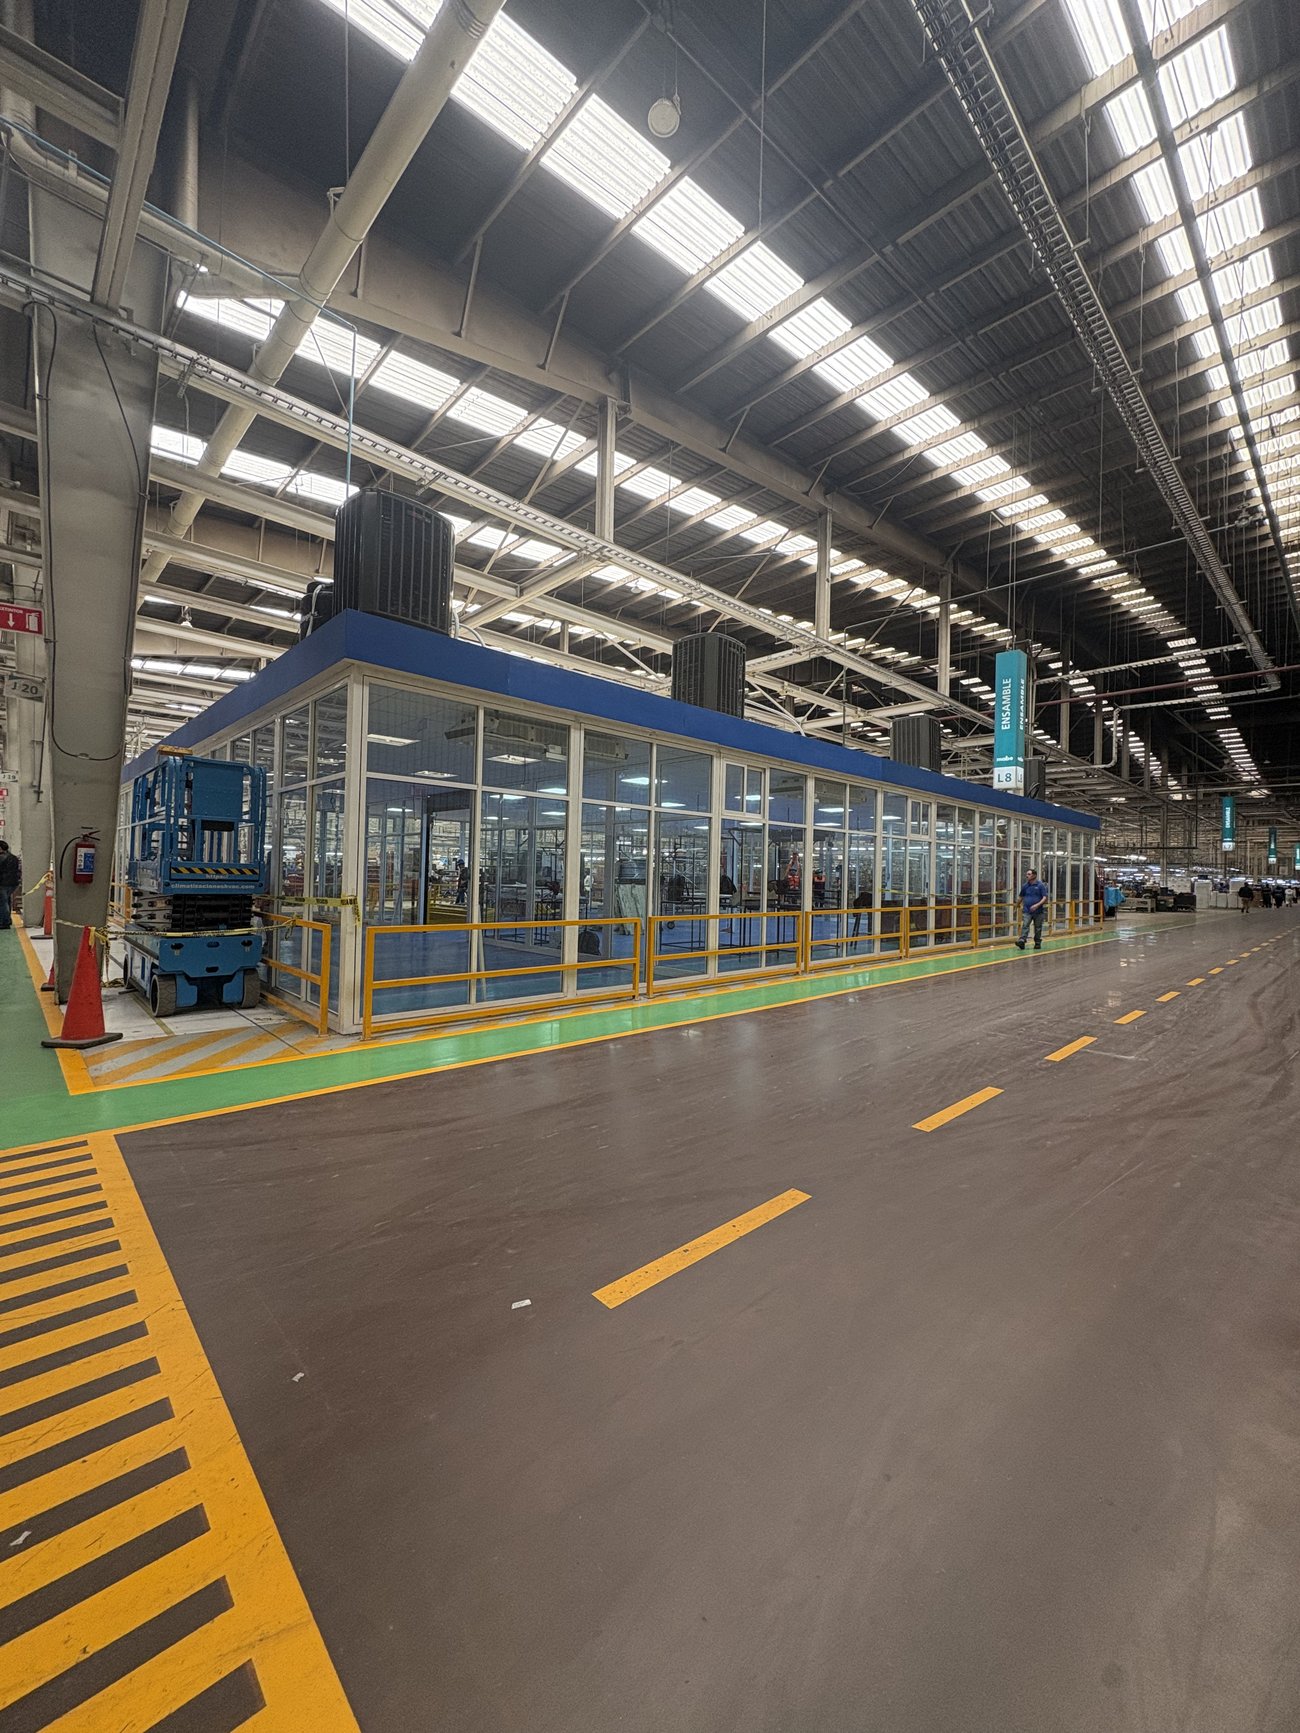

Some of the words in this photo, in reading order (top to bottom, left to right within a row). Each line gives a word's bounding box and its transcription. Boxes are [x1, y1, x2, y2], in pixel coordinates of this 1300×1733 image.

[11, 681, 17, 690] J
[21, 683, 39, 695] 20
[1001, 678, 1011, 730] ENSAMBLE
[997, 772, 1012, 783] L8
